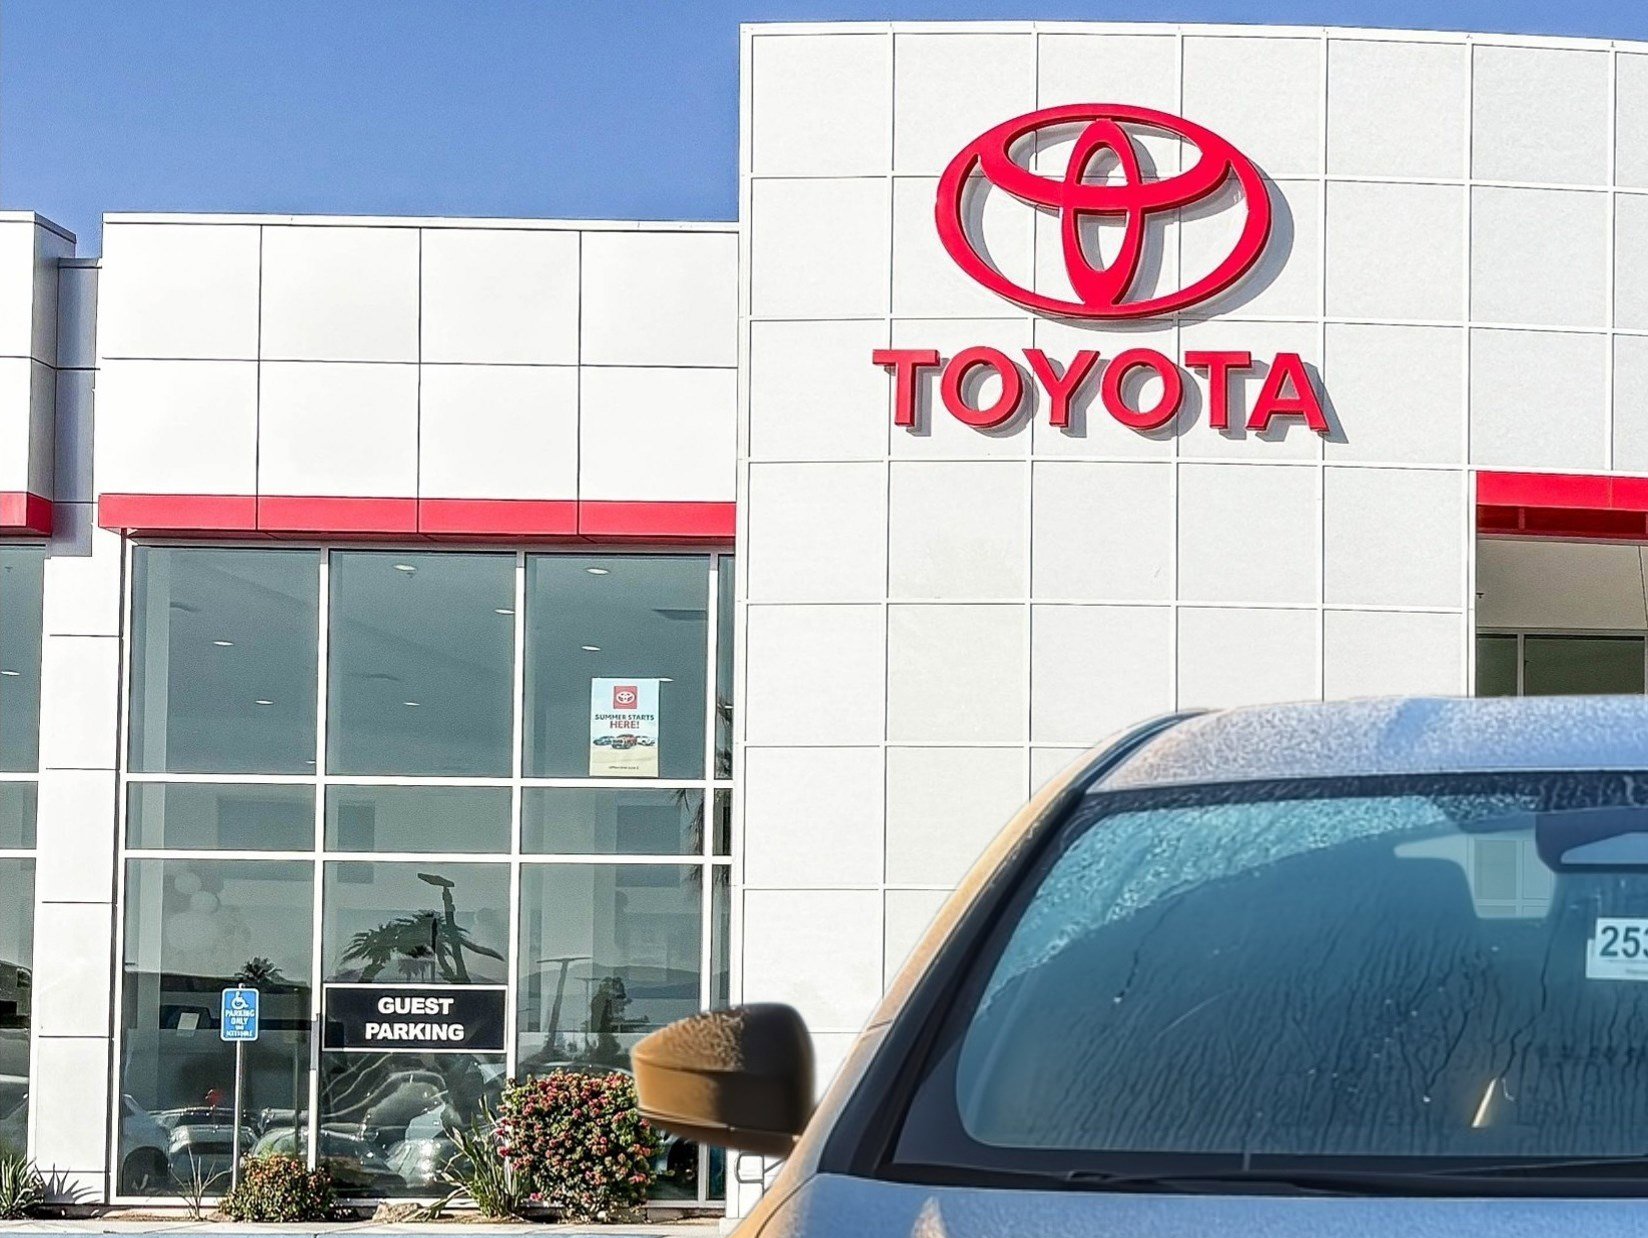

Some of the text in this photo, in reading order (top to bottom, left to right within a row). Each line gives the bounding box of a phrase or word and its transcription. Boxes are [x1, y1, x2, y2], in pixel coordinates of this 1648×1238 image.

[872, 346, 1330, 433] TOYOTA
[609, 720, 640, 729] HERE!
[377, 997, 454, 1015] GUEST
[365, 1022, 465, 1041] PARKING
